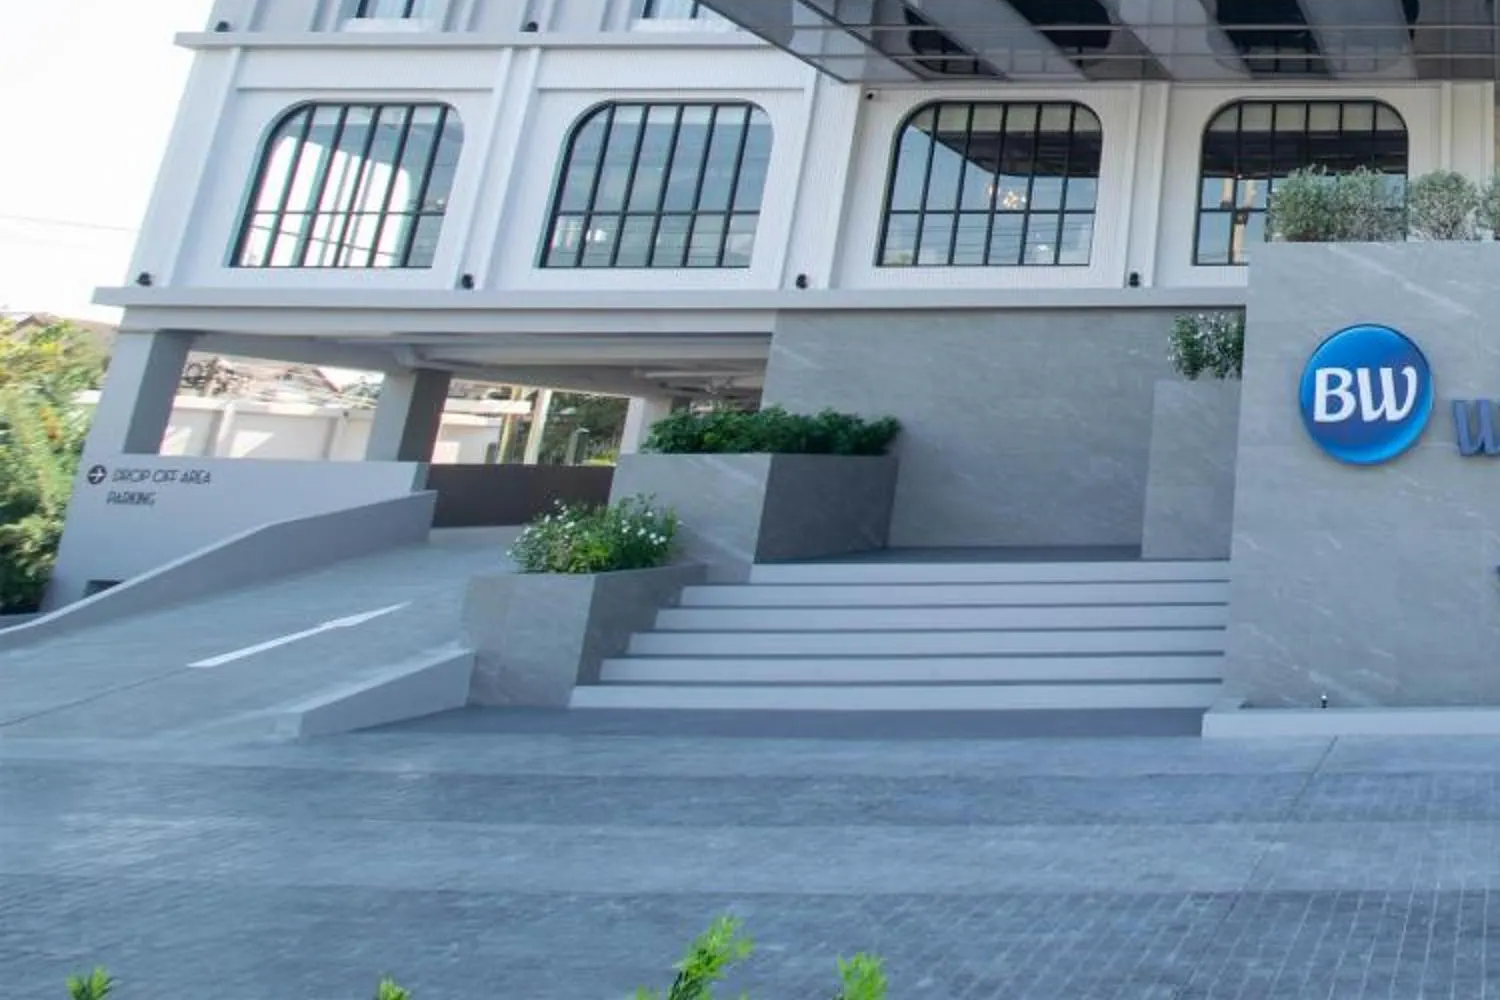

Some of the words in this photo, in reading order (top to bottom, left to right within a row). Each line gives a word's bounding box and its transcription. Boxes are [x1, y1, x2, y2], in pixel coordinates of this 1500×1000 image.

[1313, 365, 1418, 423] BW
[111, 468, 150, 483] DROP
[151, 468, 179, 483] OFF
[179, 469, 212, 485] AREA
[106, 490, 157, 506] PARKING
